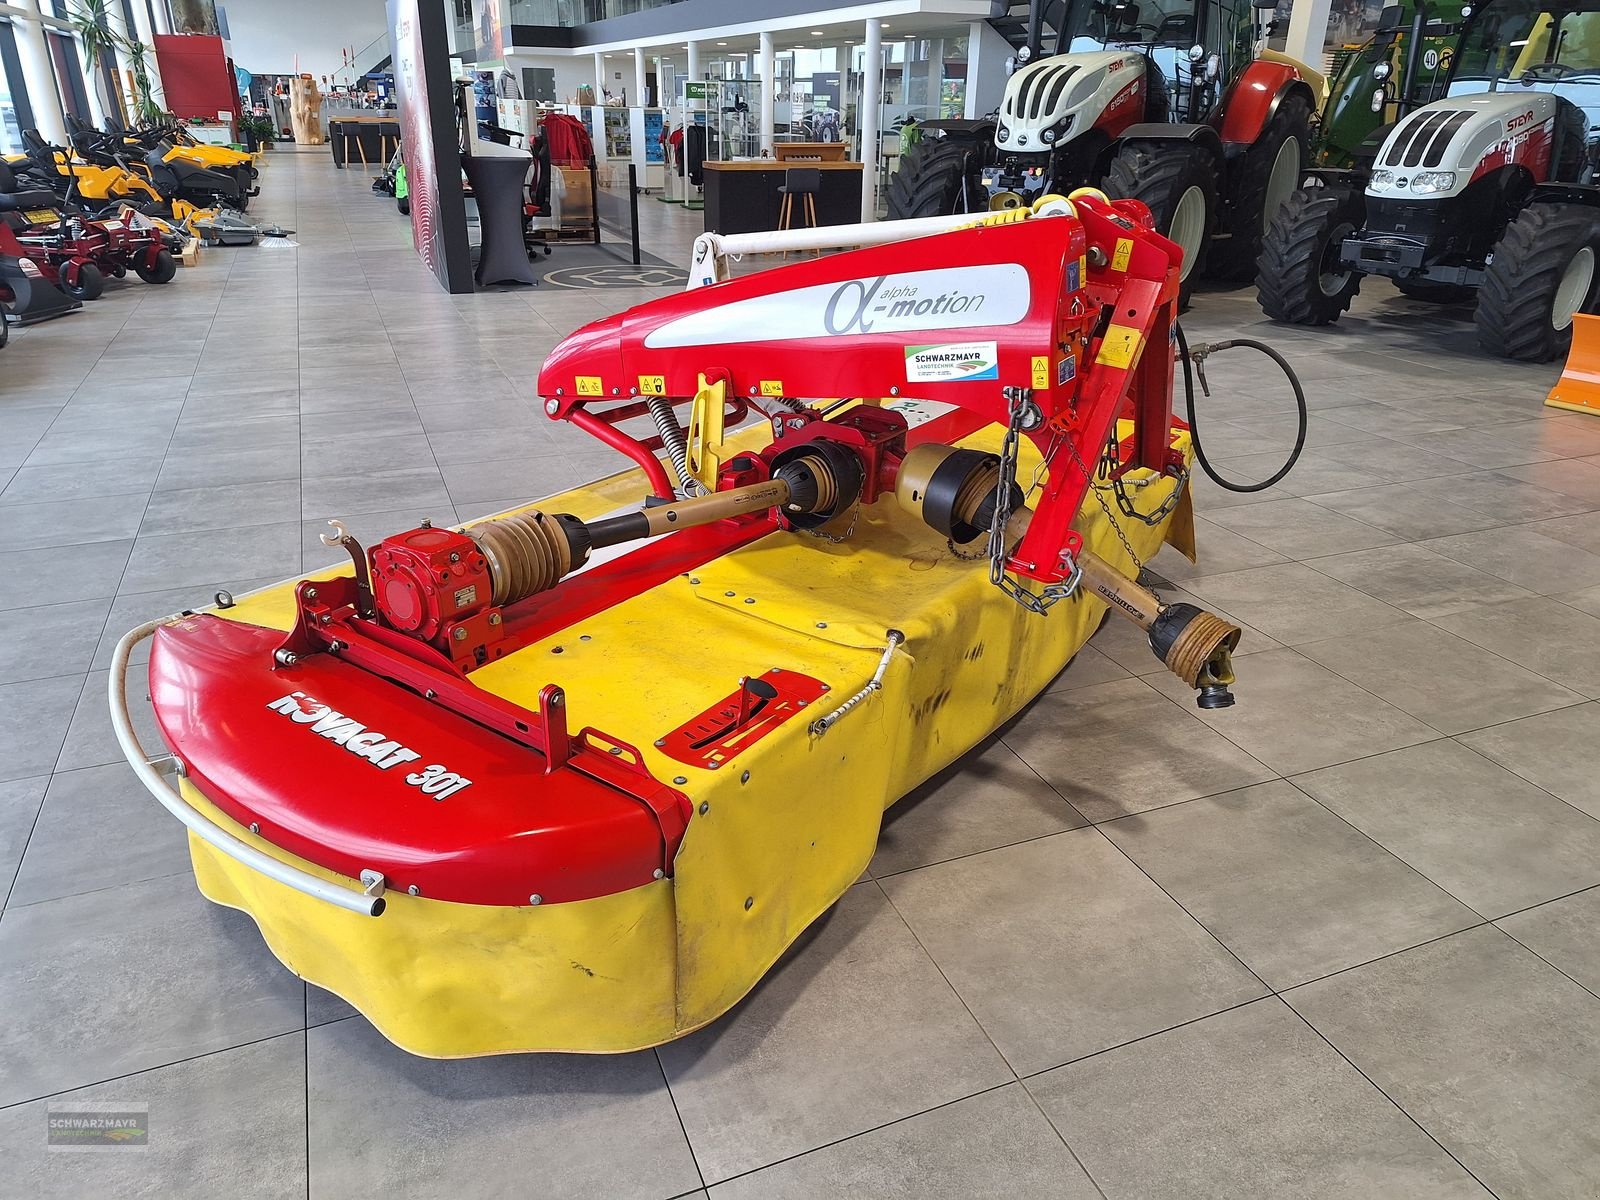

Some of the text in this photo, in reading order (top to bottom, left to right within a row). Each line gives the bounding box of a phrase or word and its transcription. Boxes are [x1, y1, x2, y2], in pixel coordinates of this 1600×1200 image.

[1108, 59, 1124, 74] STEYR
[1425, 52, 1436, 66] 40
[1507, 110, 1534, 132] STEYR
[880, 285, 918, 300] alpha
[915, 352, 981, 363] SCHWARZMAYR
[266, 691, 473, 801] NOVACAT 301
